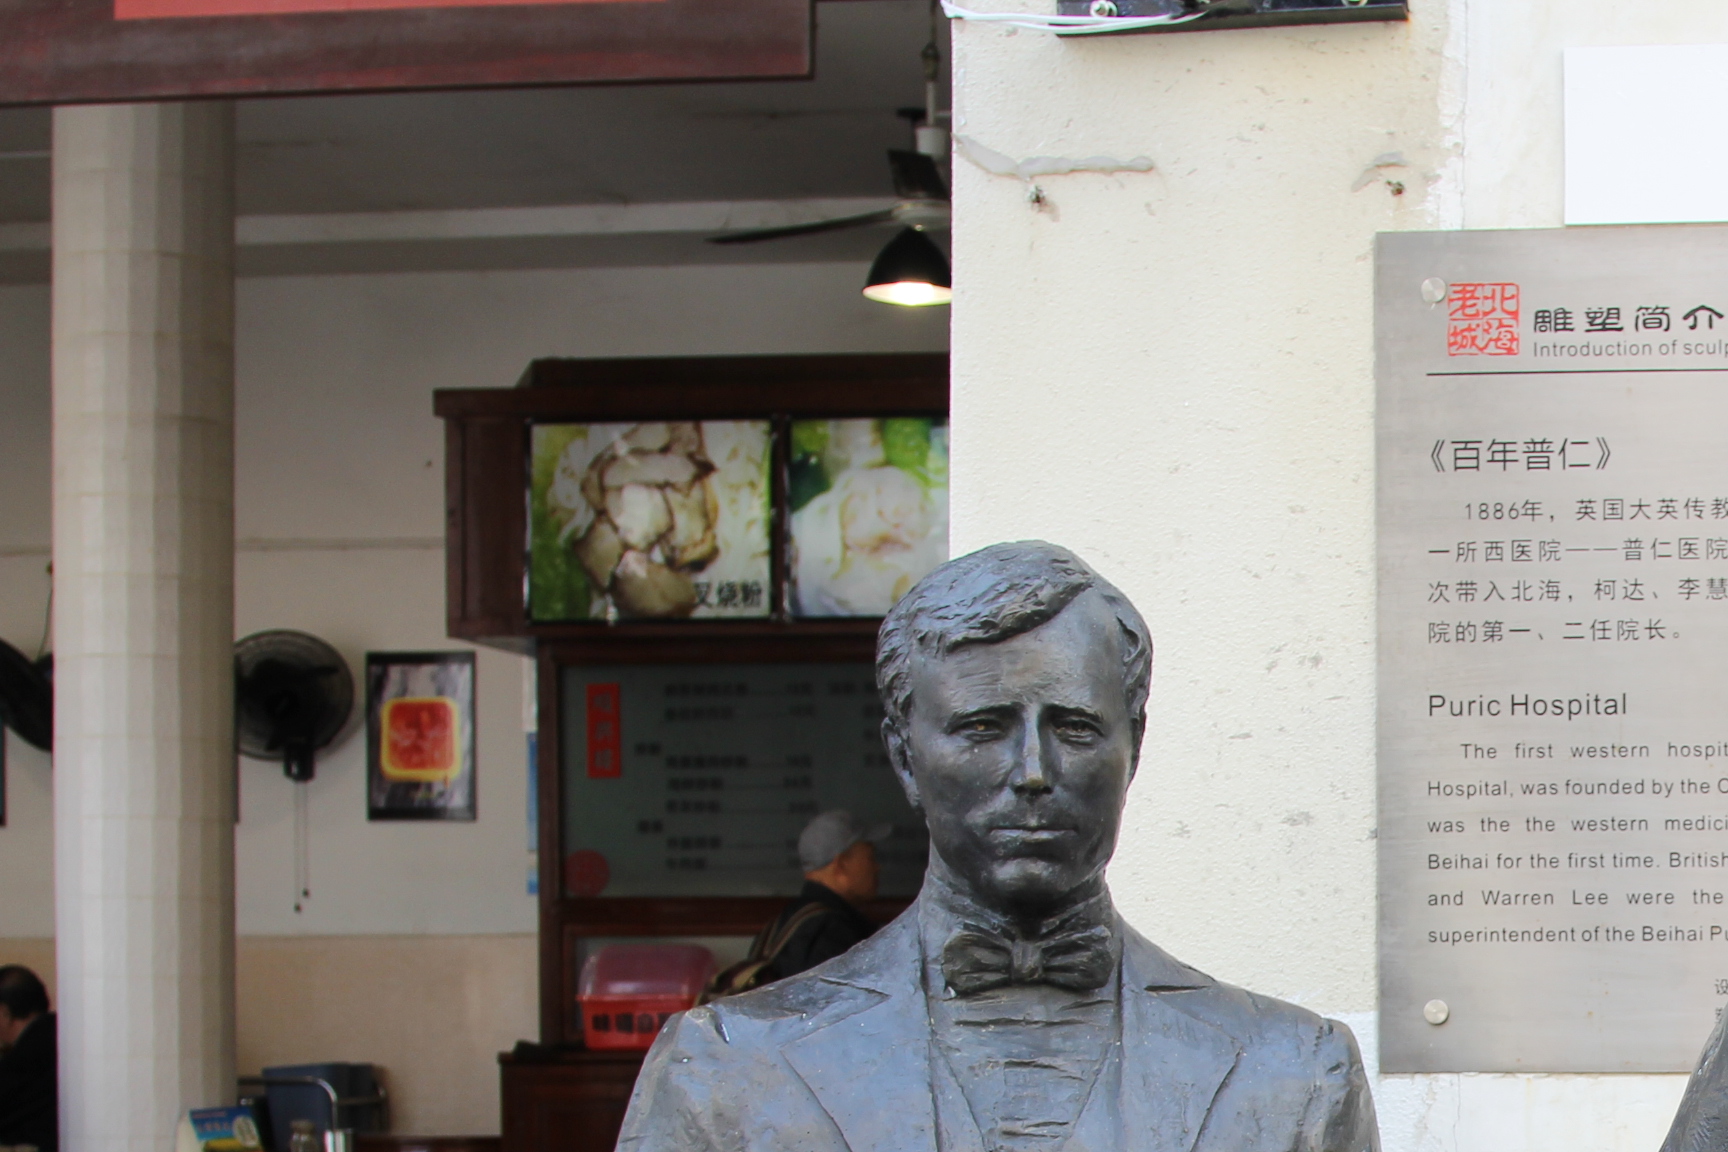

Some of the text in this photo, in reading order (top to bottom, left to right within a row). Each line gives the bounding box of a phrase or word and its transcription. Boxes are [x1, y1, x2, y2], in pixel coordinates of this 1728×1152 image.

[1533, 304, 1725, 334] 雕塑简介
[1534, 340, 1653, 357] Introduction
[1659, 339, 1677, 355] of
[1429, 437, 1613, 473] 《百年普仁》
[1428, 617, 1685, 644] 院的第一、二任院长。
[1429, 692, 1627, 721] Puric Hospital
[1460, 744, 1497, 759] The
[1515, 743, 1553, 759] first
[1571, 744, 1650, 758] western
[1428, 780, 1513, 799] Hospital,
[1521, 783, 1558, 795] was
[1565, 779, 1644, 795] founded
[1652, 779, 1674, 798] by
[1681, 778, 1710, 794] the
[1428, 821, 1464, 833] was
[1480, 817, 1510, 832] the
[1526, 817, 1555, 832] the
[1571, 817, 1648, 831] western
[1428, 854, 1488, 869] Beihai
[1497, 853, 1522, 869] for
[1530, 853, 1559, 868] the
[1568, 853, 1604, 868] first
[1613, 853, 1660, 868] time.
[1428, 891, 1463, 906] and
[1482, 890, 1554, 905] Warren
[1573, 890, 1608, 905] Lee
[1626, 893, 1674, 905] were
[1693, 889, 1723, 904] the
[1428, 927, 1575, 945] superintendent
[1581, 926, 1600, 942] of
[1605, 926, 1635, 942] the
[1642, 926, 1702, 942] Beihai
